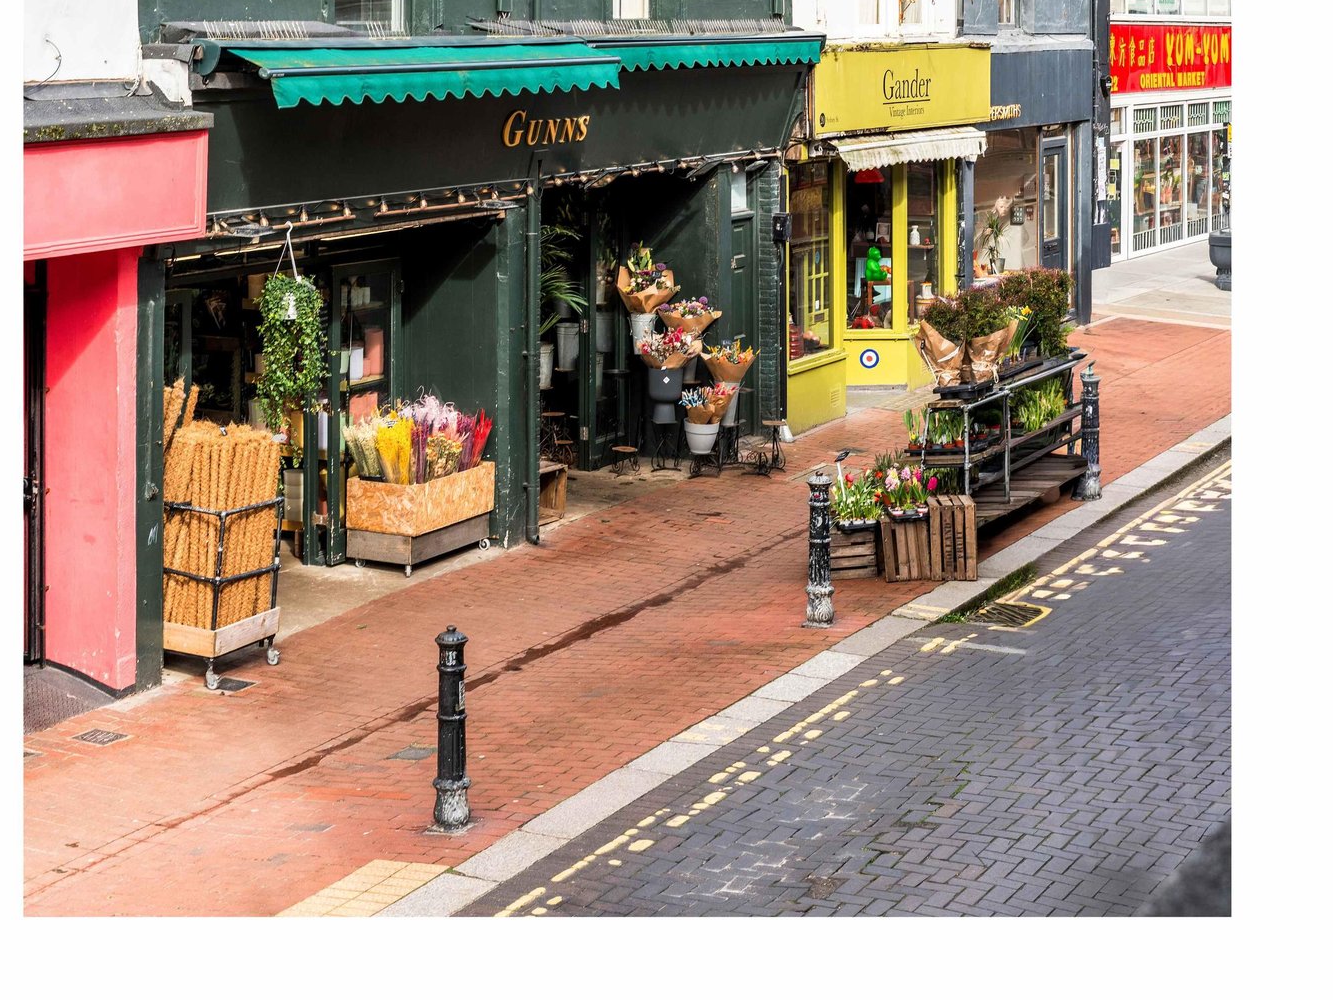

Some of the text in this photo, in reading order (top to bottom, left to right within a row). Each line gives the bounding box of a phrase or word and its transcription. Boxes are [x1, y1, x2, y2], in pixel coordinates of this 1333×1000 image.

[882, 68, 932, 101] Gander
[1140, 71, 1206, 88] ORIENTAL MARKET
[889, 104, 924, 119] Vintage Interiors
[502, 110, 590, 147] GUNNS
